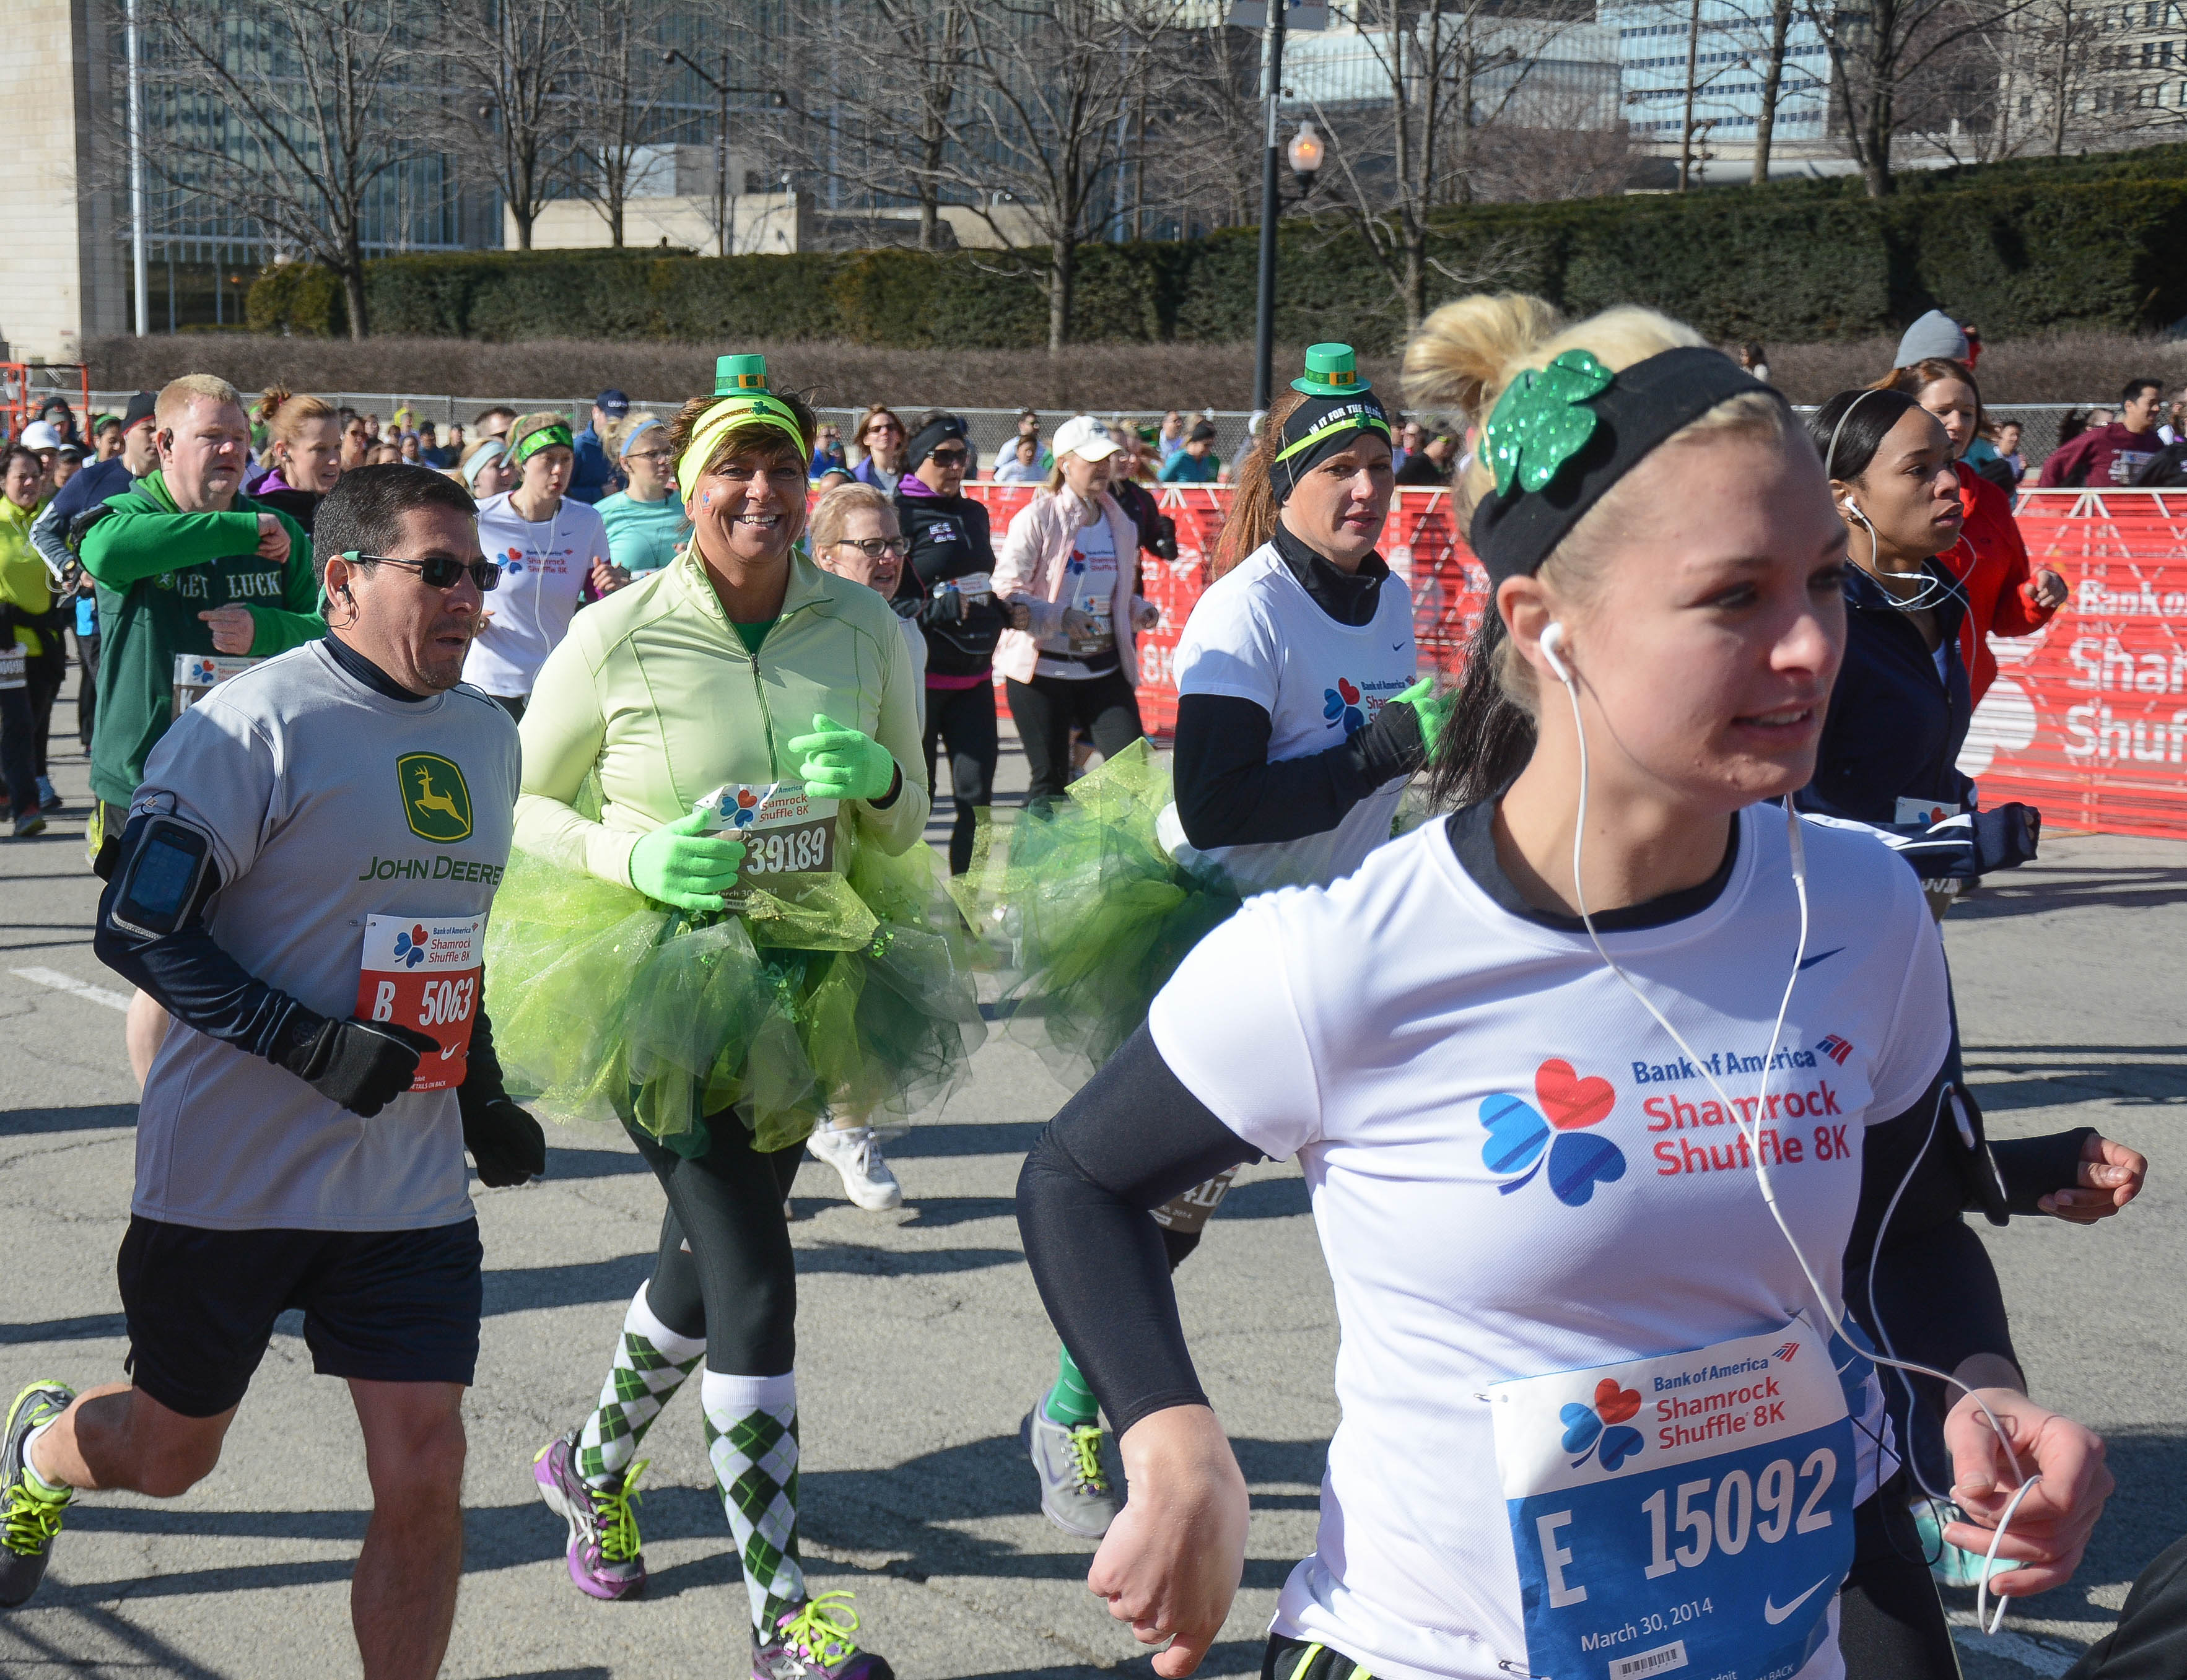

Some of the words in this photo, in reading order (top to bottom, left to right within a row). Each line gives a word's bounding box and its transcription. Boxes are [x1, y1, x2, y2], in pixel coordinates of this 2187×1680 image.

[1309, 422, 1320, 435] IN
[1318, 416, 1328, 429] IT
[1327, 407, 1347, 422] FOR
[1347, 404, 1363, 414] THE
[2076, 579, 2163, 617] Bank
[797, 804, 809, 816] 8K
[359, 856, 429, 881] JOHN
[433, 855, 504, 886] DEERE
[746, 827, 826, 876] 39189
[431, 938, 471, 950] Shamrock
[433, 927, 446, 935] Bank
[446, 927, 452, 935] of
[452, 927, 471, 935] America
[429, 951, 459, 963] Shuffle
[372, 980, 396, 1022] B
[419, 977, 474, 1026] 5063
[1631, 1056, 1696, 1084] Bank
[1726, 1047, 1818, 1075] America
[1642, 1079, 1843, 1133] Shamrock
[1652, 1128, 1804, 1177] Shuffle
[1814, 1124, 1851, 1162] 8K
[1653, 1372, 1692, 1392] Bank
[1692, 1366, 1708, 1384] of
[1709, 1357, 1770, 1381] America
[1656, 1376, 1780, 1422] Shamrock
[1658, 1412, 1746, 1450] Shuffle
[1753, 1399, 1786, 1427] 8K
[1536, 1510, 1587, 1609] E
[1641, 1447, 1837, 1580] 15092
[1581, 1620, 1638, 1652] March
[1640, 1613, 1669, 1634] 30,
[1671, 1597, 1714, 1626] 2014
